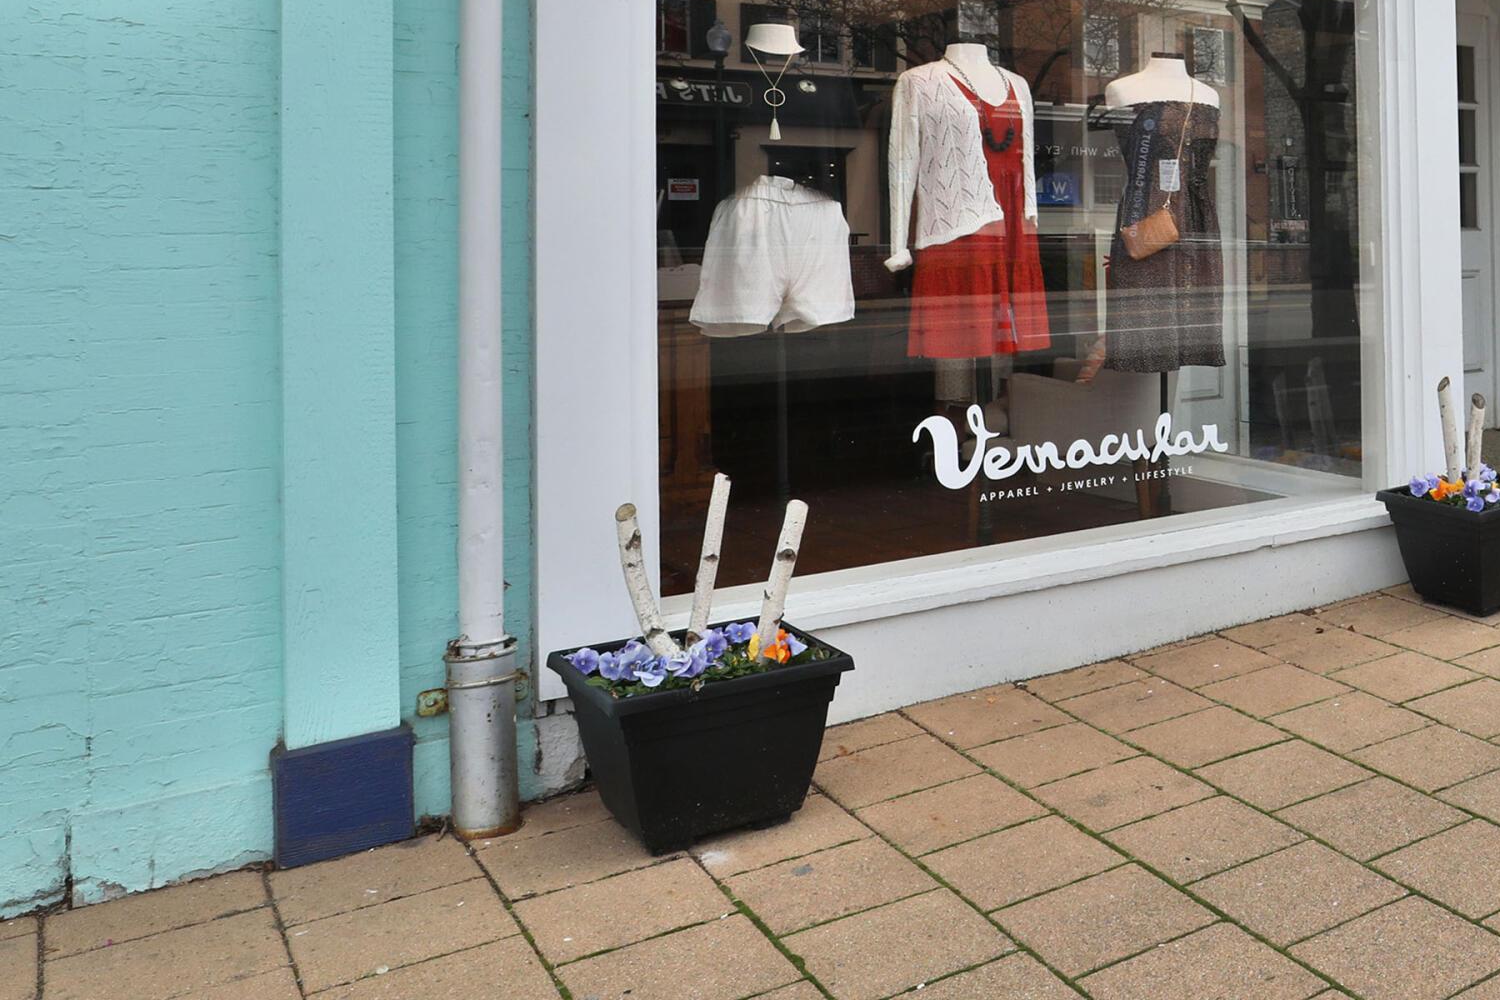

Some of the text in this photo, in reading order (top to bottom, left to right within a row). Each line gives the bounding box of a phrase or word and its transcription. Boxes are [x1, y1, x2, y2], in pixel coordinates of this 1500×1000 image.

[912, 404, 1228, 490] Vernacular
[980, 486, 1040, 502] APPAREL
[1060, 475, 1116, 492] JEWELRY
[1134, 465, 1194, 482] LIFESTYLE
